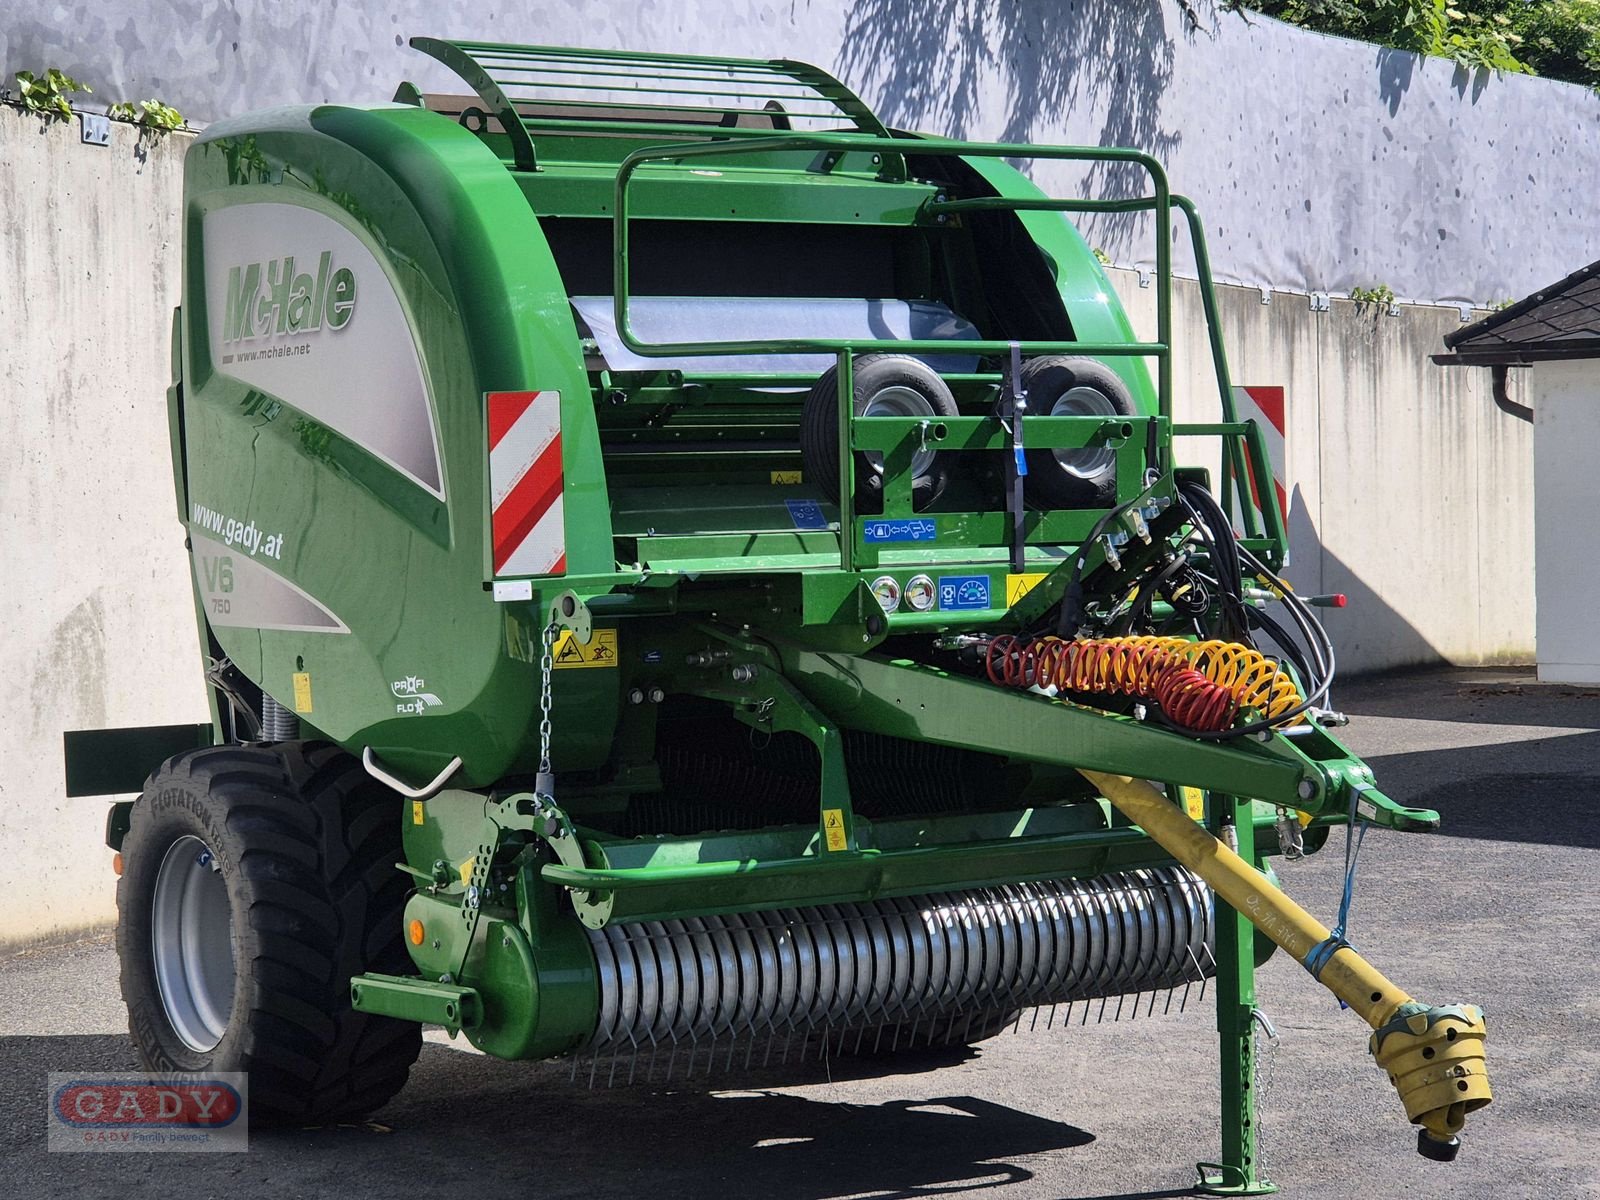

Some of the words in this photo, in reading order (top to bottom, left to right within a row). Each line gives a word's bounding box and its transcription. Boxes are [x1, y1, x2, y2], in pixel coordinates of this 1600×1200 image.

[223, 250, 356, 343] McHale
[237, 343, 310, 362] www.mchale.net
[194, 503, 283, 560] www.gady.at
[202, 556, 234, 593] V6
[212, 599, 231, 614] 750
[150, 787, 212, 830] FLOTATION
